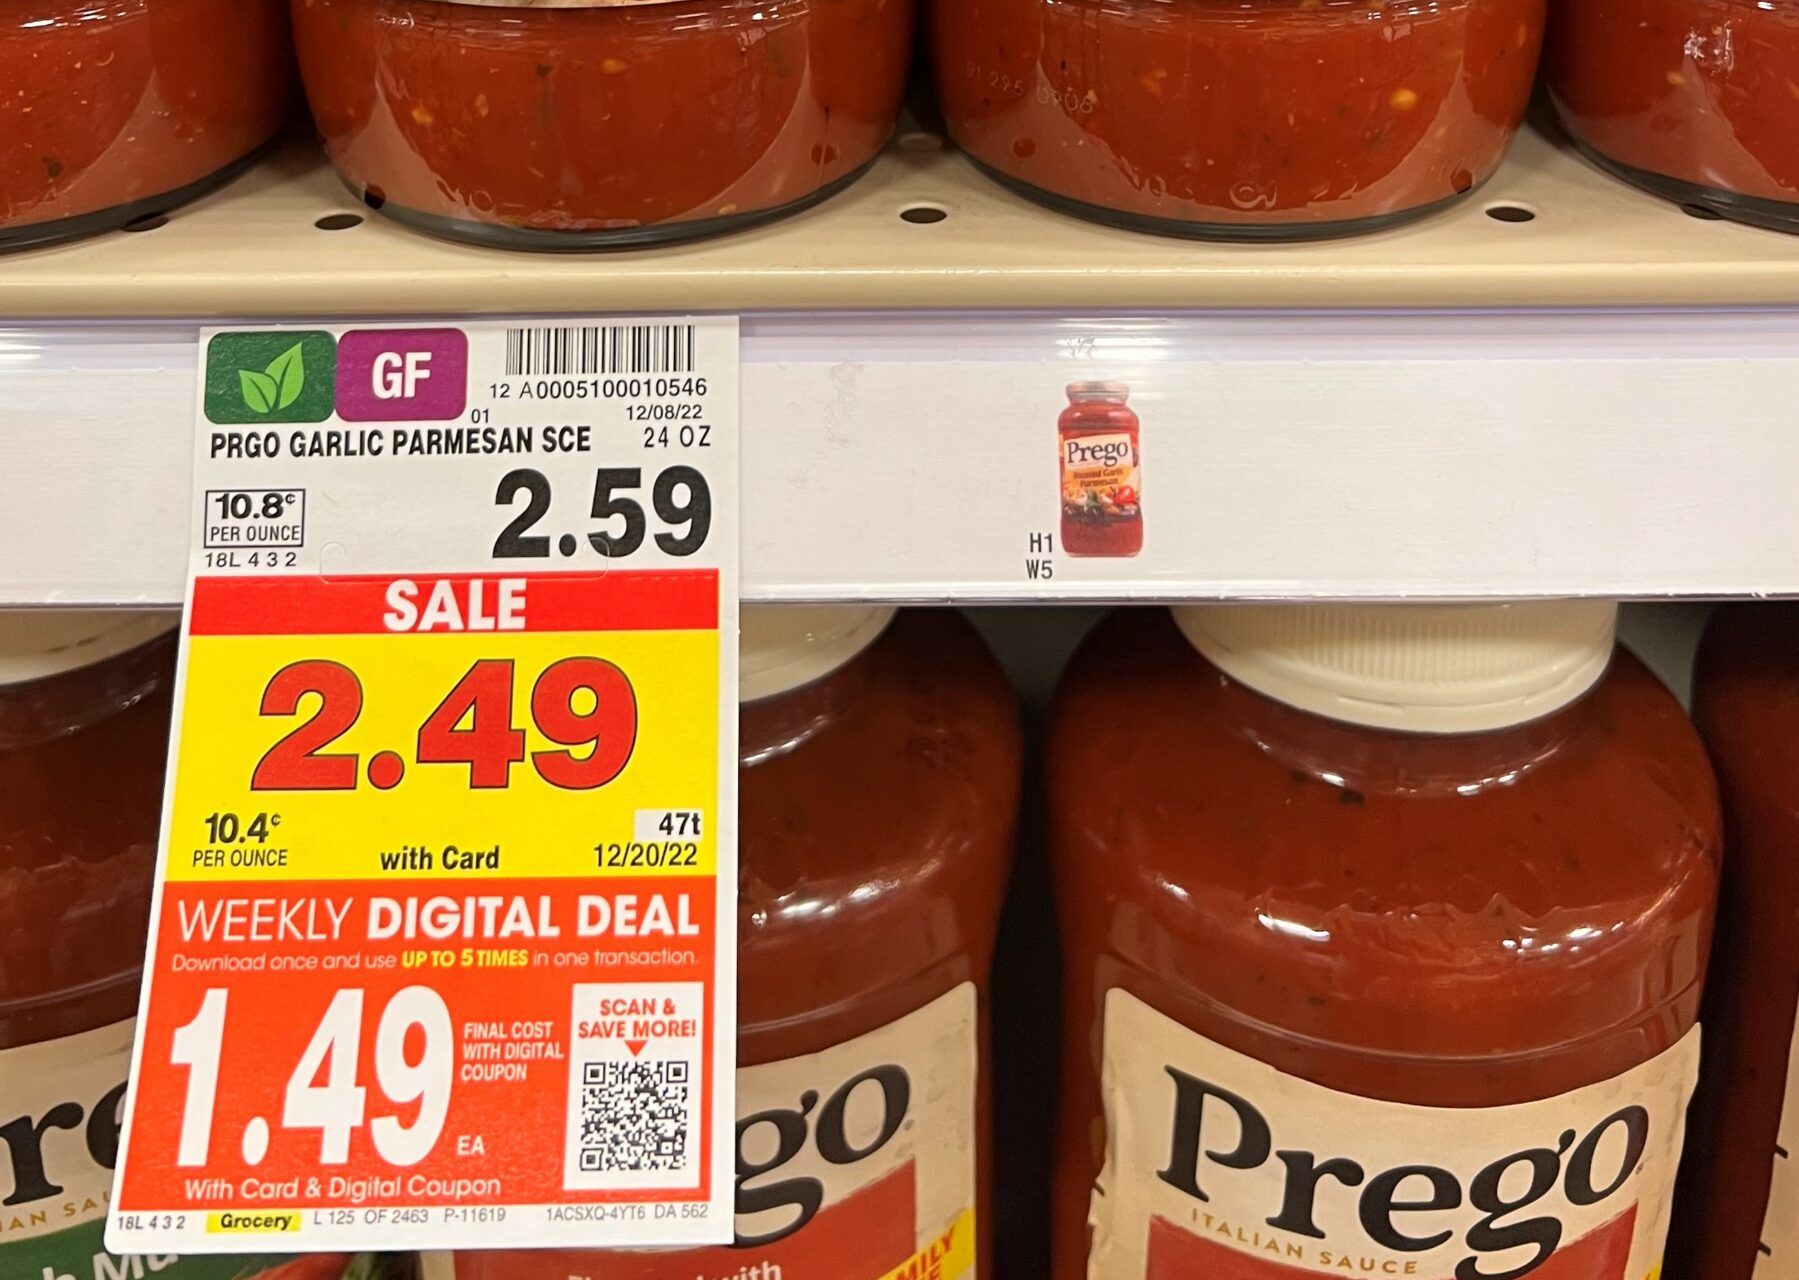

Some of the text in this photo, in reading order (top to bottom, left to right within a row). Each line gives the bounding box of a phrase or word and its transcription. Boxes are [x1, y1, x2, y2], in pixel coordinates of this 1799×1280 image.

[372, 351, 432, 400] GF
[490, 383, 510, 399] 12
[472, 404, 703, 424] 01 12/08/22
[211, 426, 591, 459] PRGO GARLIC PARMESAN SCE
[644, 425, 711, 449] 24 OZ
[1067, 441, 1128, 467] Prego
[493, 465, 712, 558] 2.59
[211, 523, 301, 542] PER OUNCE
[1029, 532, 1053, 553] H1
[205, 551, 241, 568] 18L
[1026, 559, 1053, 580] W5
[383, 578, 527, 631] SALE
[250, 655, 638, 791] 2.49
[659, 812, 701, 836] 47t
[193, 848, 288, 867] PER OUNCE
[380, 845, 500, 870] with Card
[593, 843, 698, 867] 12/20/22
[178, 893, 700, 942] WEEKLY DIGITAL DEAL
[172, 948, 699, 971] Download once and use UP TO 5 TIMES in one transaction.
[600, 998, 676, 1016] SCAN &
[463, 1021, 554, 1039] FINAL COST
[578, 1020, 696, 1039] SAVE MORE!
[463, 1042, 564, 1059] WITH DIGITAL
[171, 985, 454, 1168] 1.49
[461, 1063, 527, 1082] COUPON
[457, 1135, 485, 1156] EA
[1156, 1064, 1649, 1280] Prego
[185, 1175, 501, 1203] With Card & Digital Coupon
[220, 1213, 292, 1231] Grocery
[313, 1207, 506, 1225] L 125 OF 2463 P-11619
[654, 1204, 677, 1219] DA
[681, 1204, 708, 1219] 562
[118, 1216, 144, 1230] 18L
[1192, 1208, 1418, 1275] ITALIAN SAUCE
